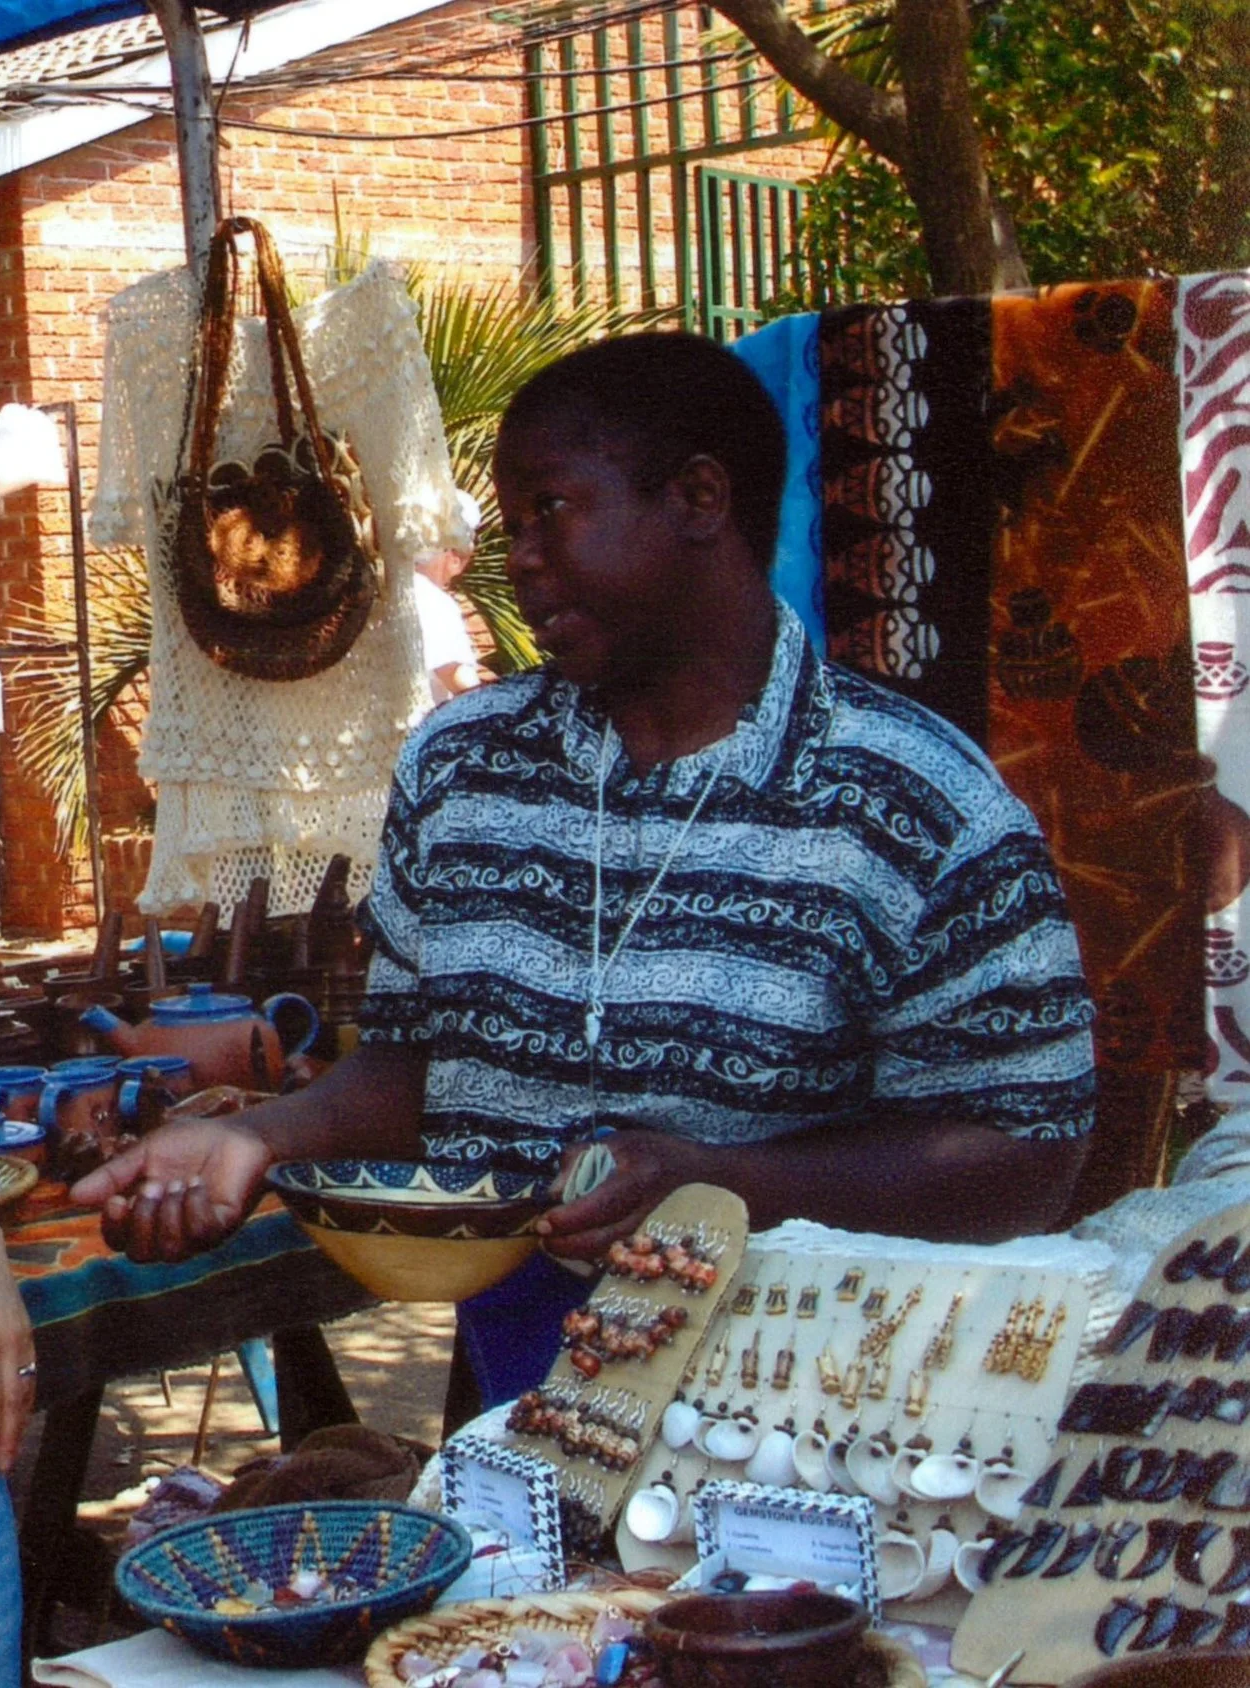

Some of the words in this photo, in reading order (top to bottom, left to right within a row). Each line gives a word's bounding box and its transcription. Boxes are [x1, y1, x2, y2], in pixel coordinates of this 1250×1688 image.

[733, 1505, 795, 1522] GEMSTONE
[799, 1513, 824, 1526] EGG
[826, 1518, 853, 1530] BOX
